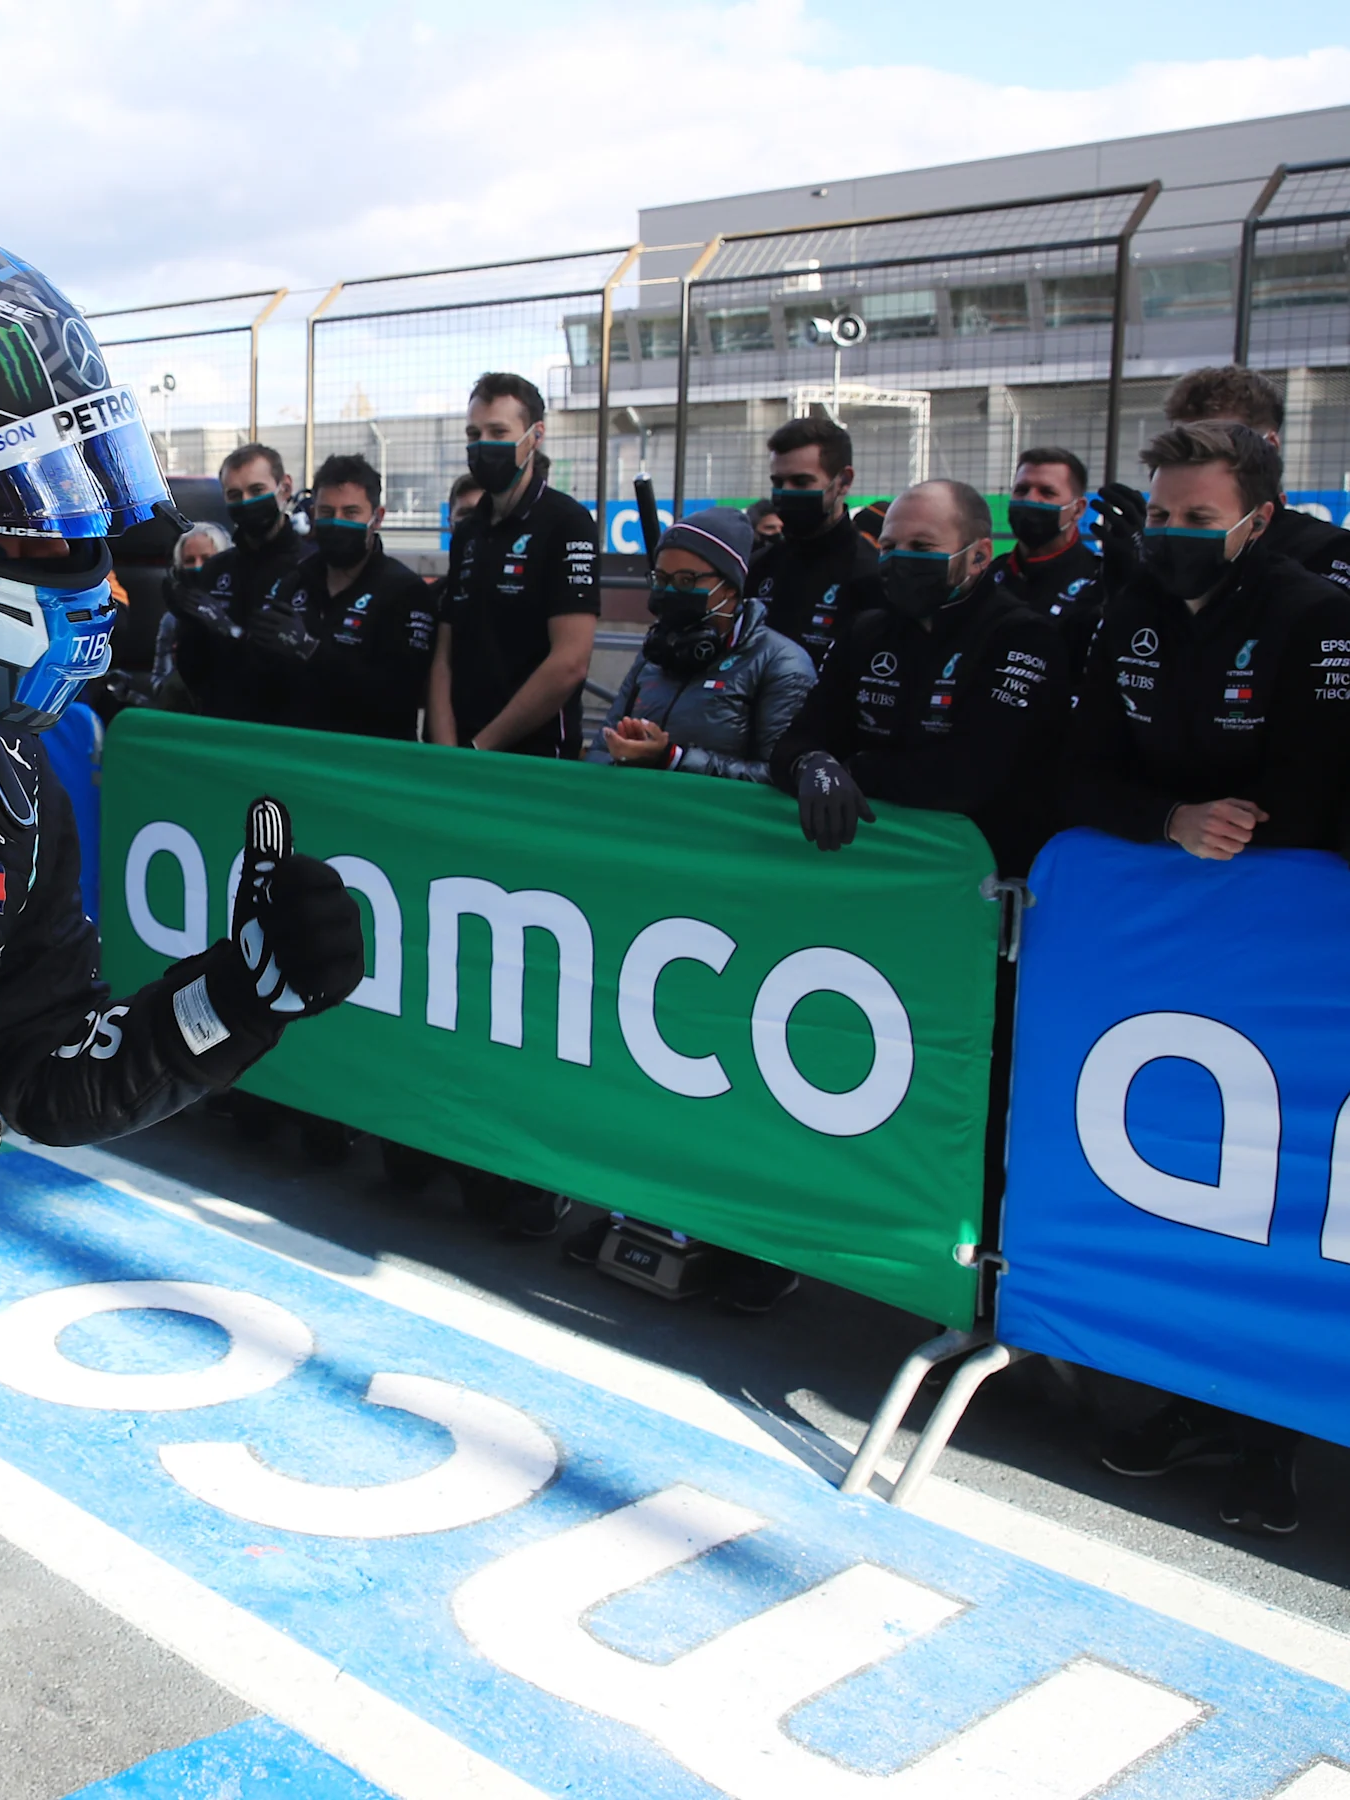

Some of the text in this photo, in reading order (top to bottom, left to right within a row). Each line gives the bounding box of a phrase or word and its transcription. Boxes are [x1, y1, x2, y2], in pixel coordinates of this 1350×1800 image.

[52, 391, 136, 441] PETRO
[72, 626, 114, 663] TIB
[1321, 640, 1350, 652] EPSO
[1007, 650, 1047, 671] EPSON
[1310, 658, 1350, 667] BOS
[1002, 677, 1030, 695] IWC
[1130, 674, 1155, 690] UBS
[1325, 672, 1350, 685] IWC
[870, 691, 897, 707] UBS
[1314, 688, 1350, 701] TIBC
[125, 820, 915, 1137] aamco
